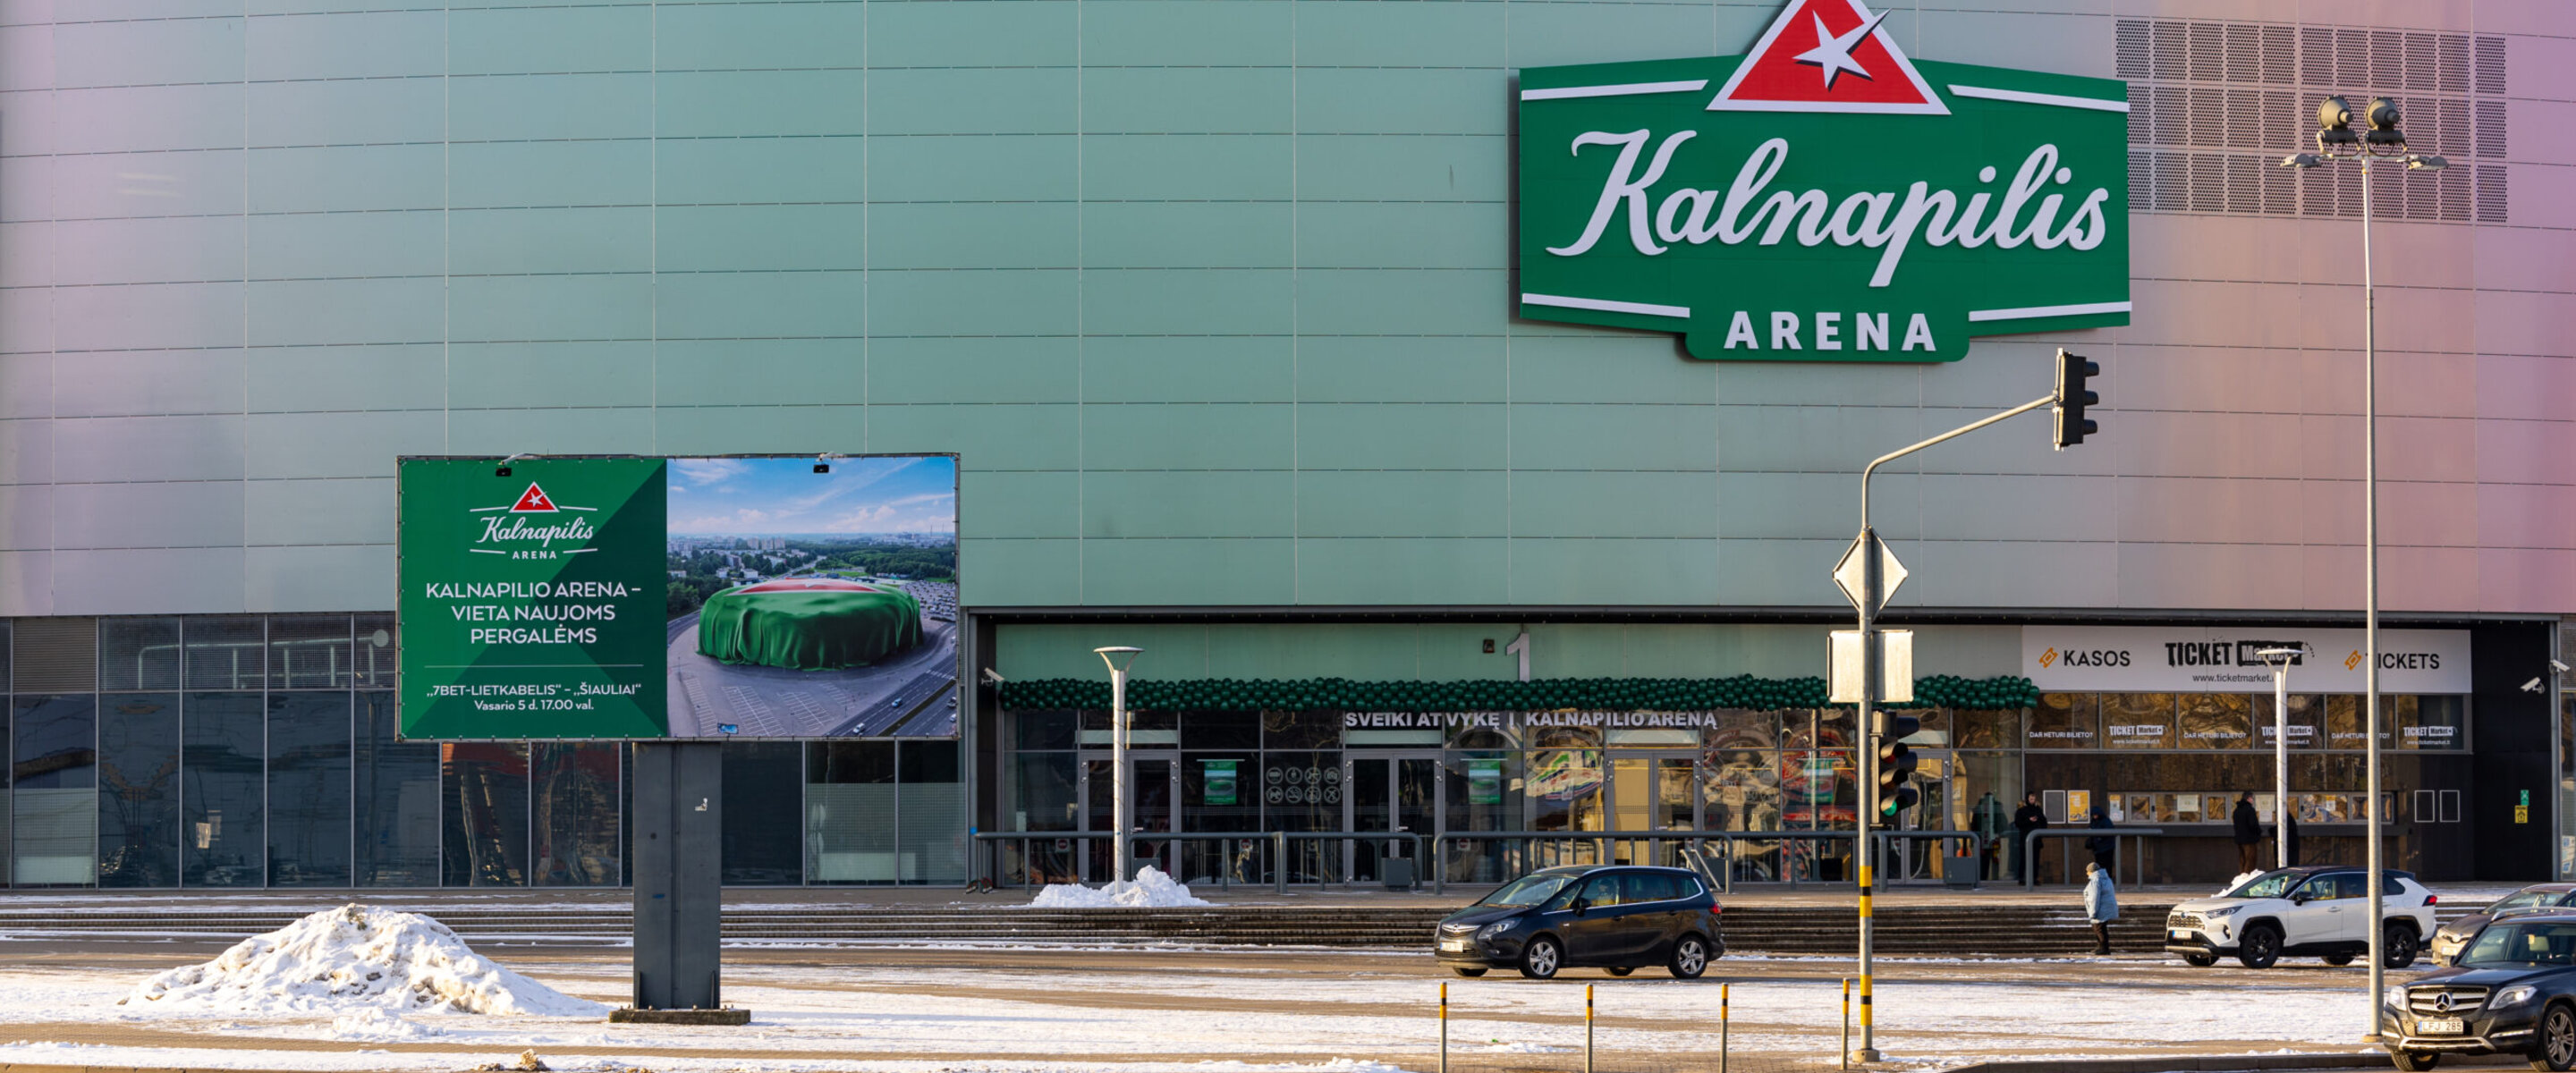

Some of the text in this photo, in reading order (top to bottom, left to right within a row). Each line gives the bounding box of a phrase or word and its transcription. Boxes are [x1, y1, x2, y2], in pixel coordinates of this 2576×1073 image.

[1545, 129, 2109, 288] Kalnapilis
[1724, 310, 1936, 351] ARENA
[475, 516, 594, 547] Kalnapilis
[512, 550, 557, 560] ARENA
[426, 582, 551, 598] KALNAPILIO
[554, 581, 628, 597] ARENA
[451, 604, 616, 621] VIETA NAUJOMS
[470, 623, 597, 644] PERGALĖMS
[2063, 650, 2131, 667] KASOS
[2165, 641, 2233, 668] TICKET
[2365, 653, 2440, 669] ICKETS
[474, 698, 595, 711] Vasario 5 d. 17.00 val.
[1344, 713, 1412, 727] SVEIKI
[1526, 712, 1644, 726] KALNAPILIO
[1648, 713, 1716, 730] ARENĄ
[2109, 725, 2136, 736] TICKET
[2403, 726, 2428, 737] TICKET
[2422, 1022, 2462, 1031] LFJ 285
